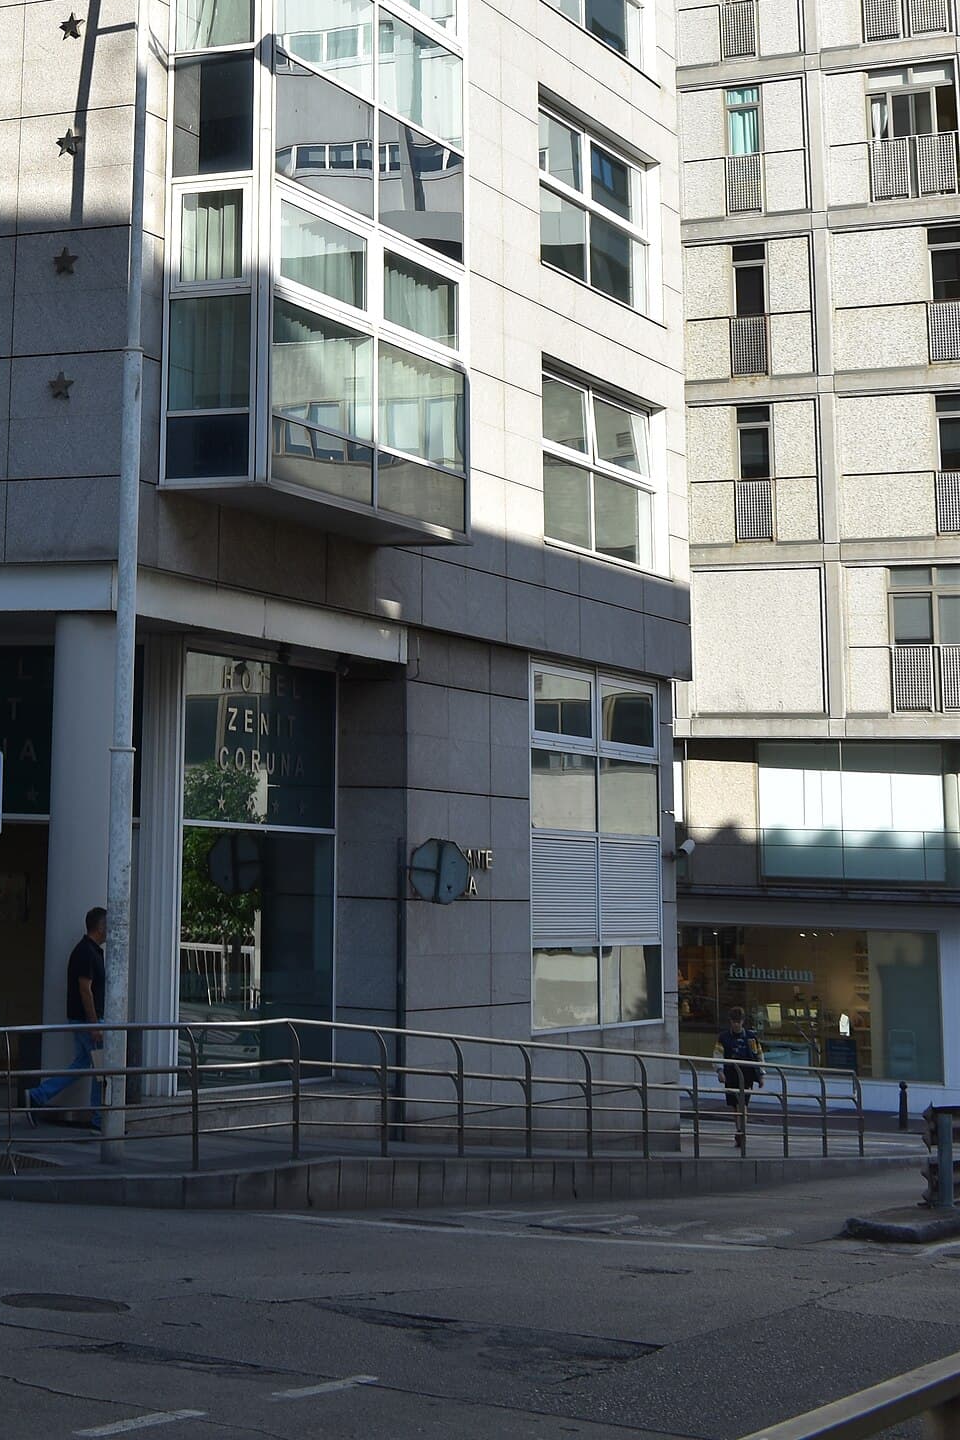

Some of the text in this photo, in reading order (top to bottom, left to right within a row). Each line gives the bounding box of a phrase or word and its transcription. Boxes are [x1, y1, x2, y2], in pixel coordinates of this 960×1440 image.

[222, 664, 302, 700] HOTEL
[227, 707, 297, 737] ZENIT
[727, 962, 814, 982] farinarium
